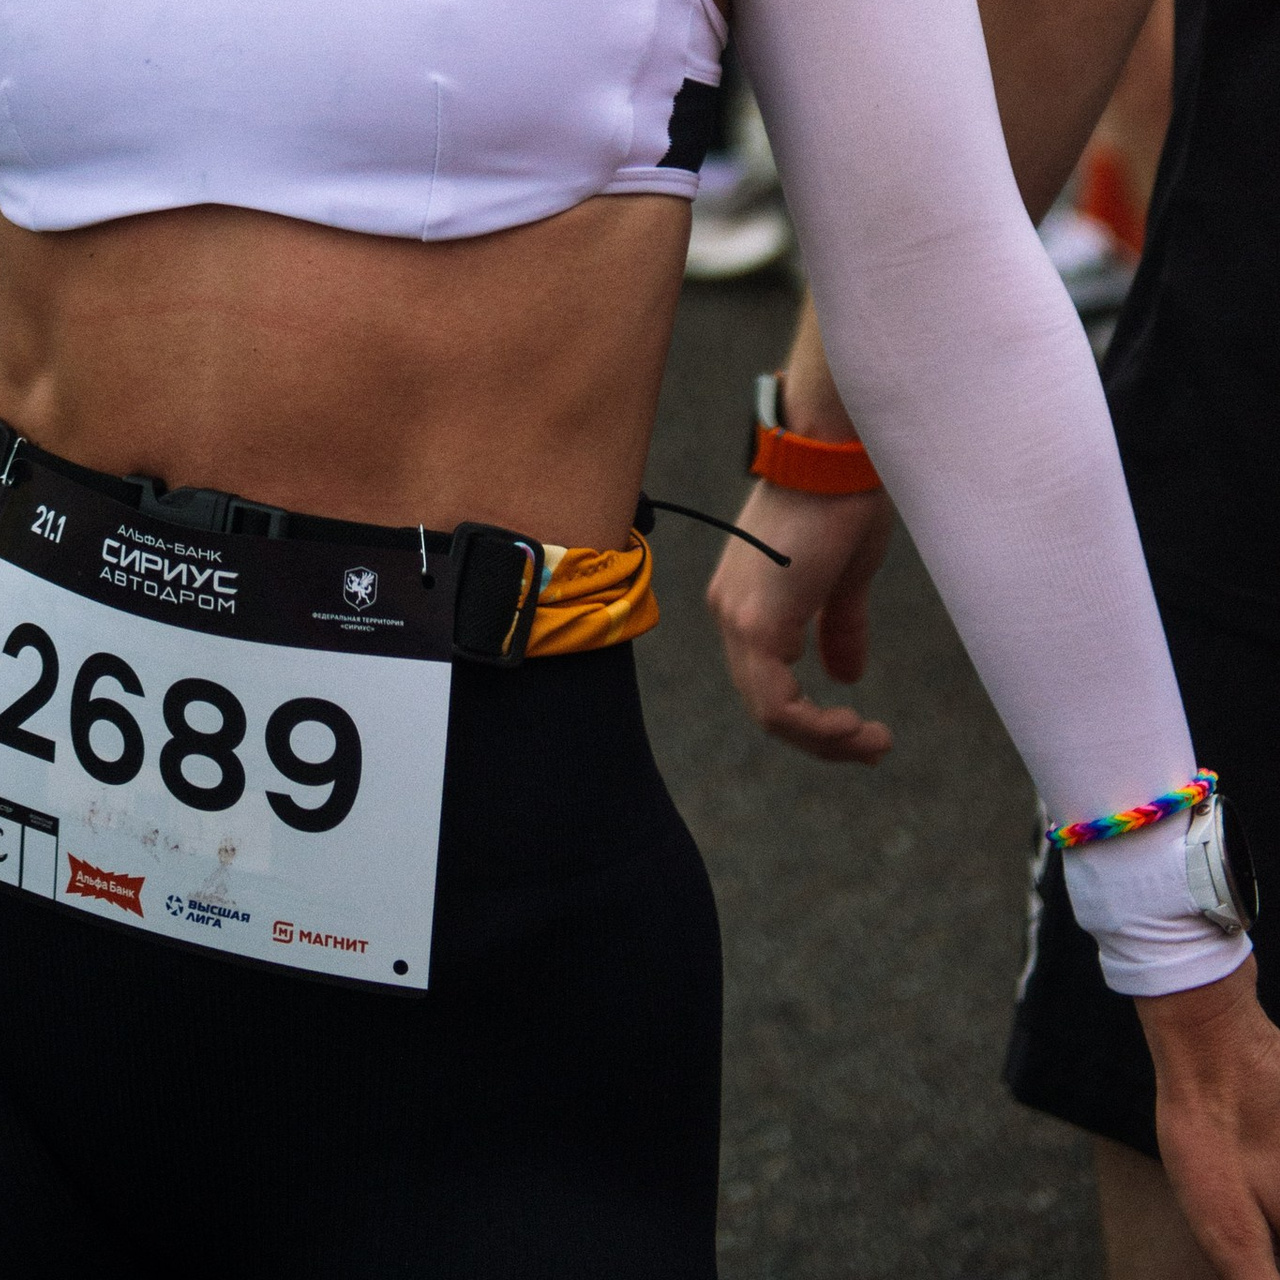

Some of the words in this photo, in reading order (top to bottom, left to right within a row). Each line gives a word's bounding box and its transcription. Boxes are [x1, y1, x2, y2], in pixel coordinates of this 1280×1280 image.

[30, 504, 67, 544] 21.1
[117, 524, 222, 563] АЛЬФА-БАНК
[101, 537, 239, 595] СИРИУС
[99, 566, 236, 614] АВТОДРОМ
[312, 612, 361, 622] ФЕДЕРАЛЬНАЯ
[362, 616, 405, 627] ТЕРРИТОРИЯ
[75, 870, 108, 891] Альфа
[109, 881, 135, 898] Банк
[185, 912, 222, 929] ЛИГА
[187, 899, 251, 923] ВЫСШАЯ
[299, 929, 369, 954] МАГНИТ
